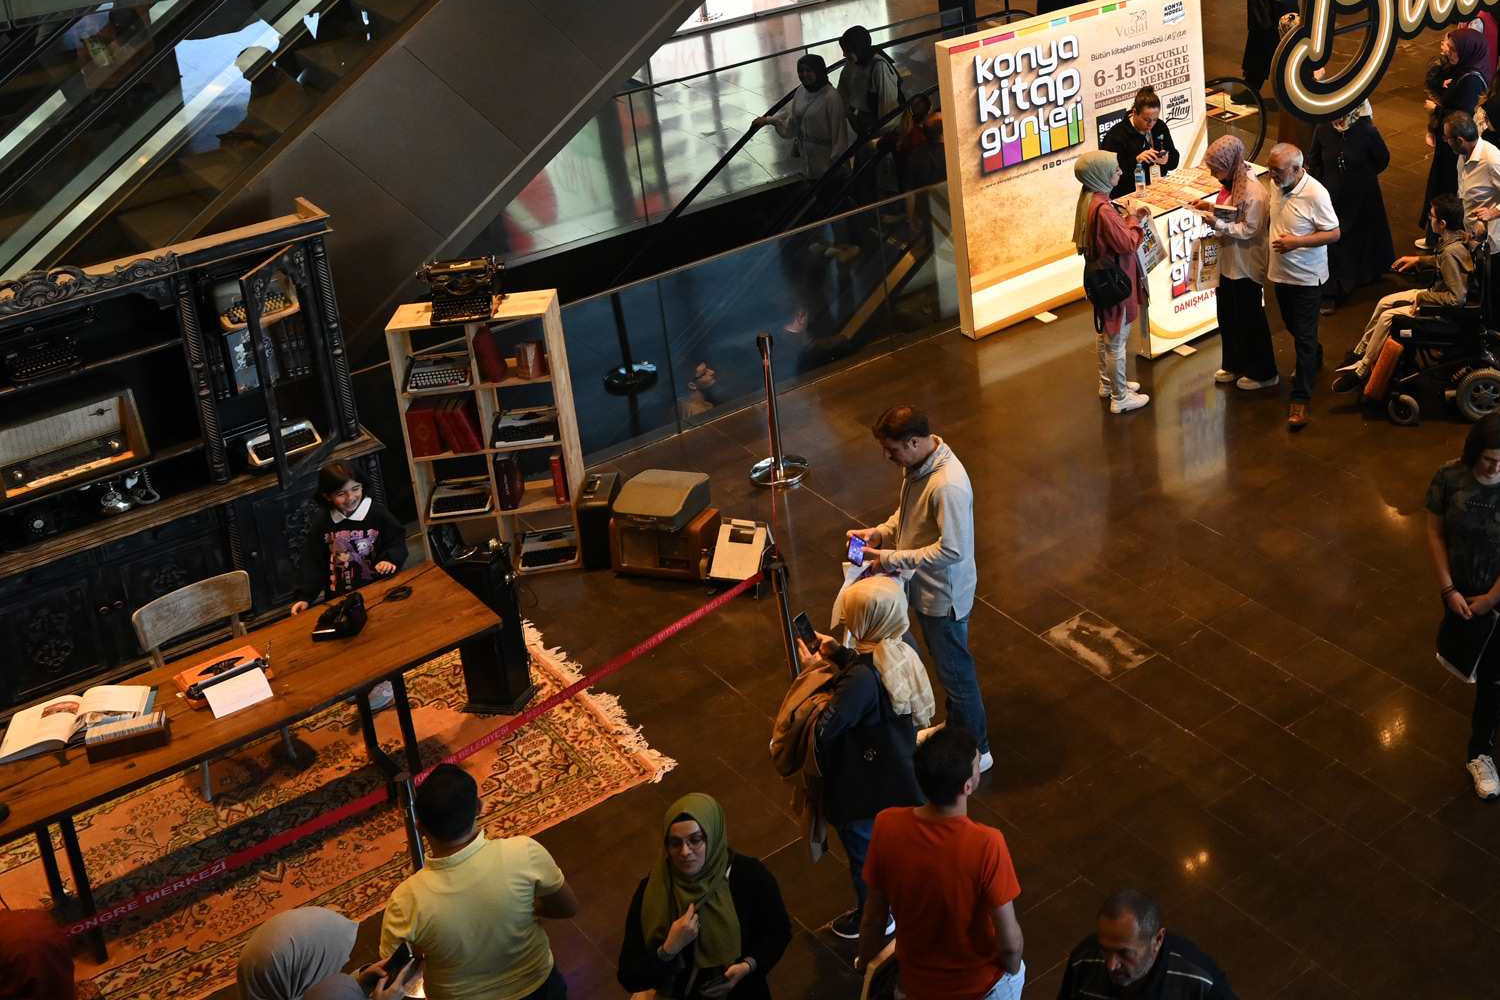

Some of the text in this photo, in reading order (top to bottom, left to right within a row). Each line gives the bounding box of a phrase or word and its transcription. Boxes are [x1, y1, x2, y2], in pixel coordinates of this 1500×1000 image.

[1115, 20, 1149, 38] Vuslat
[974, 34, 1080, 85] konya
[1091, 51, 1111, 62] Bütün
[1111, 43, 1141, 56] kitapların
[1141, 36, 1164, 48] önsözü
[1093, 60, 1137, 88] 6-15
[1140, 54, 1190, 77] KONGRE
[1140, 63, 1190, 87] MERKEZİ
[977, 67, 1082, 123] kitap
[1095, 80, 1137, 100] EKİM 2023
[981, 95, 1084, 159] günleri
[1174, 292, 1210, 315] DANIŞMA
[458, 724, 511, 762] BELEDİYESİ
[630, 636, 657, 657] KONYA
[705, 581, 747, 614] BELEDİYESİ
[144, 861, 228, 904] MERKEZİ
